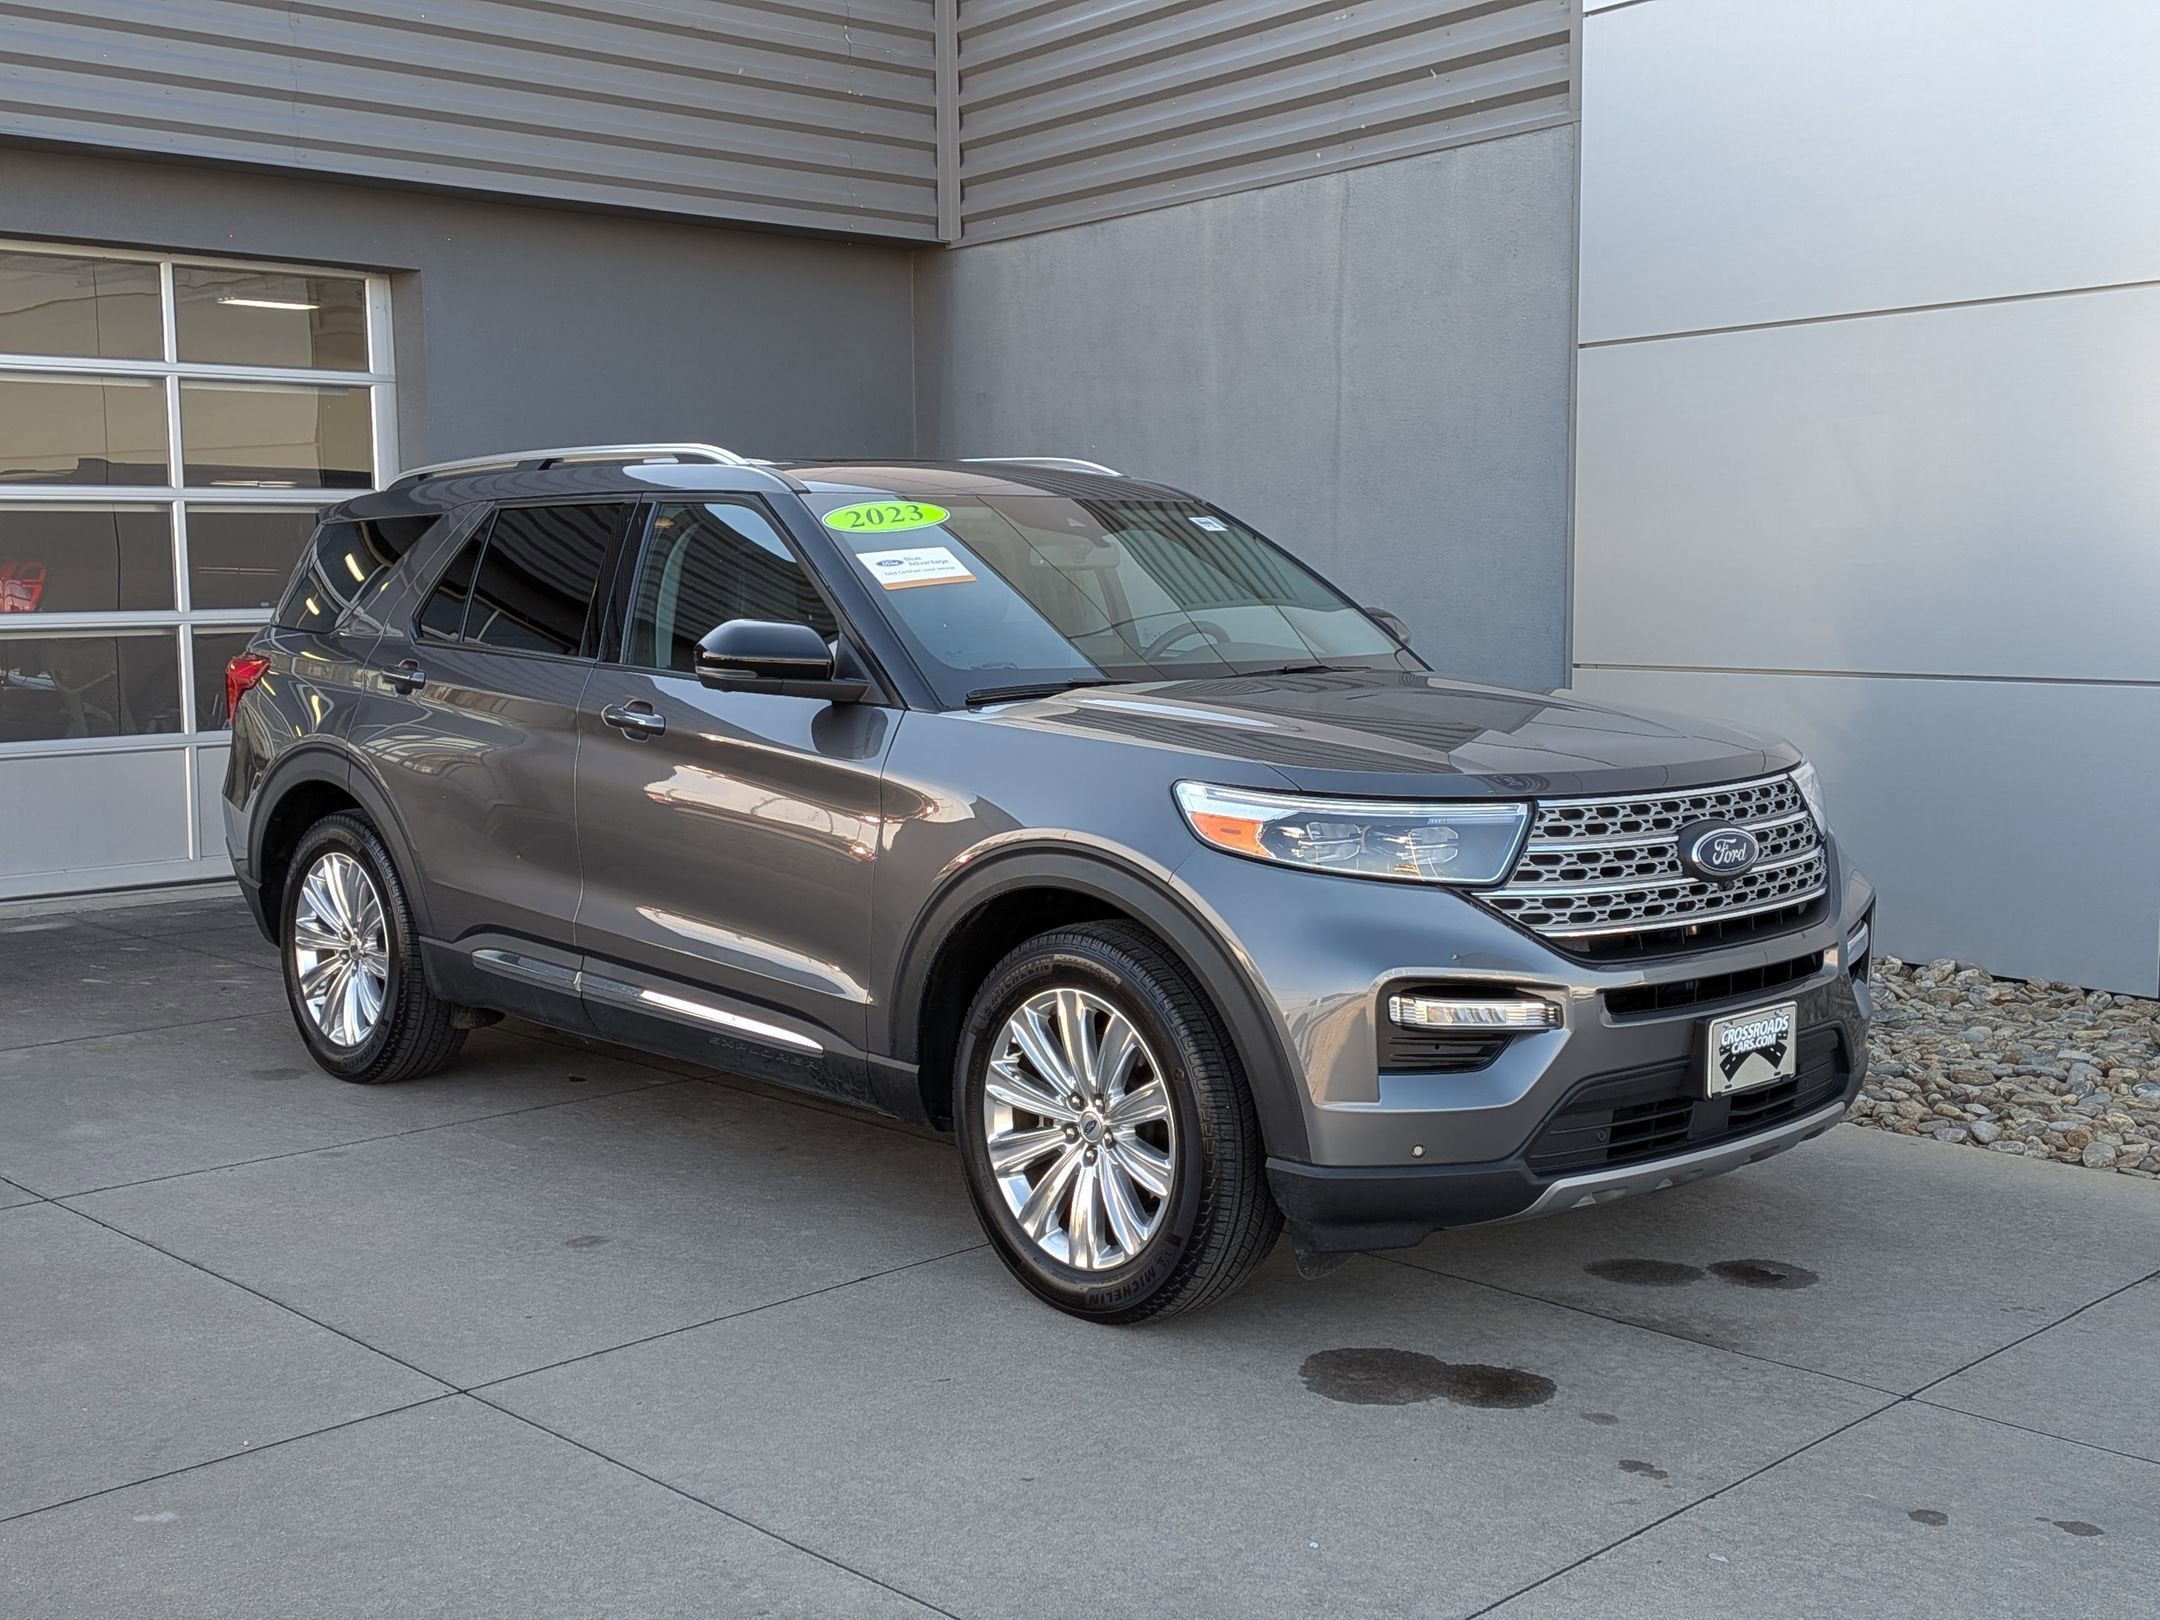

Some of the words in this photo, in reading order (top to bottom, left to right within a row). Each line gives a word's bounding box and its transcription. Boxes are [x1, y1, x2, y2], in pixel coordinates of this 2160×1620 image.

[845, 504, 924, 529] 2023
[1712, 838, 1748, 866] Ford
[1720, 1015, 1790, 1046] CROSSROADS
[1731, 1033, 1777, 1054] CARS.COM
[1088, 1265, 1157, 1305] MICHELIN
